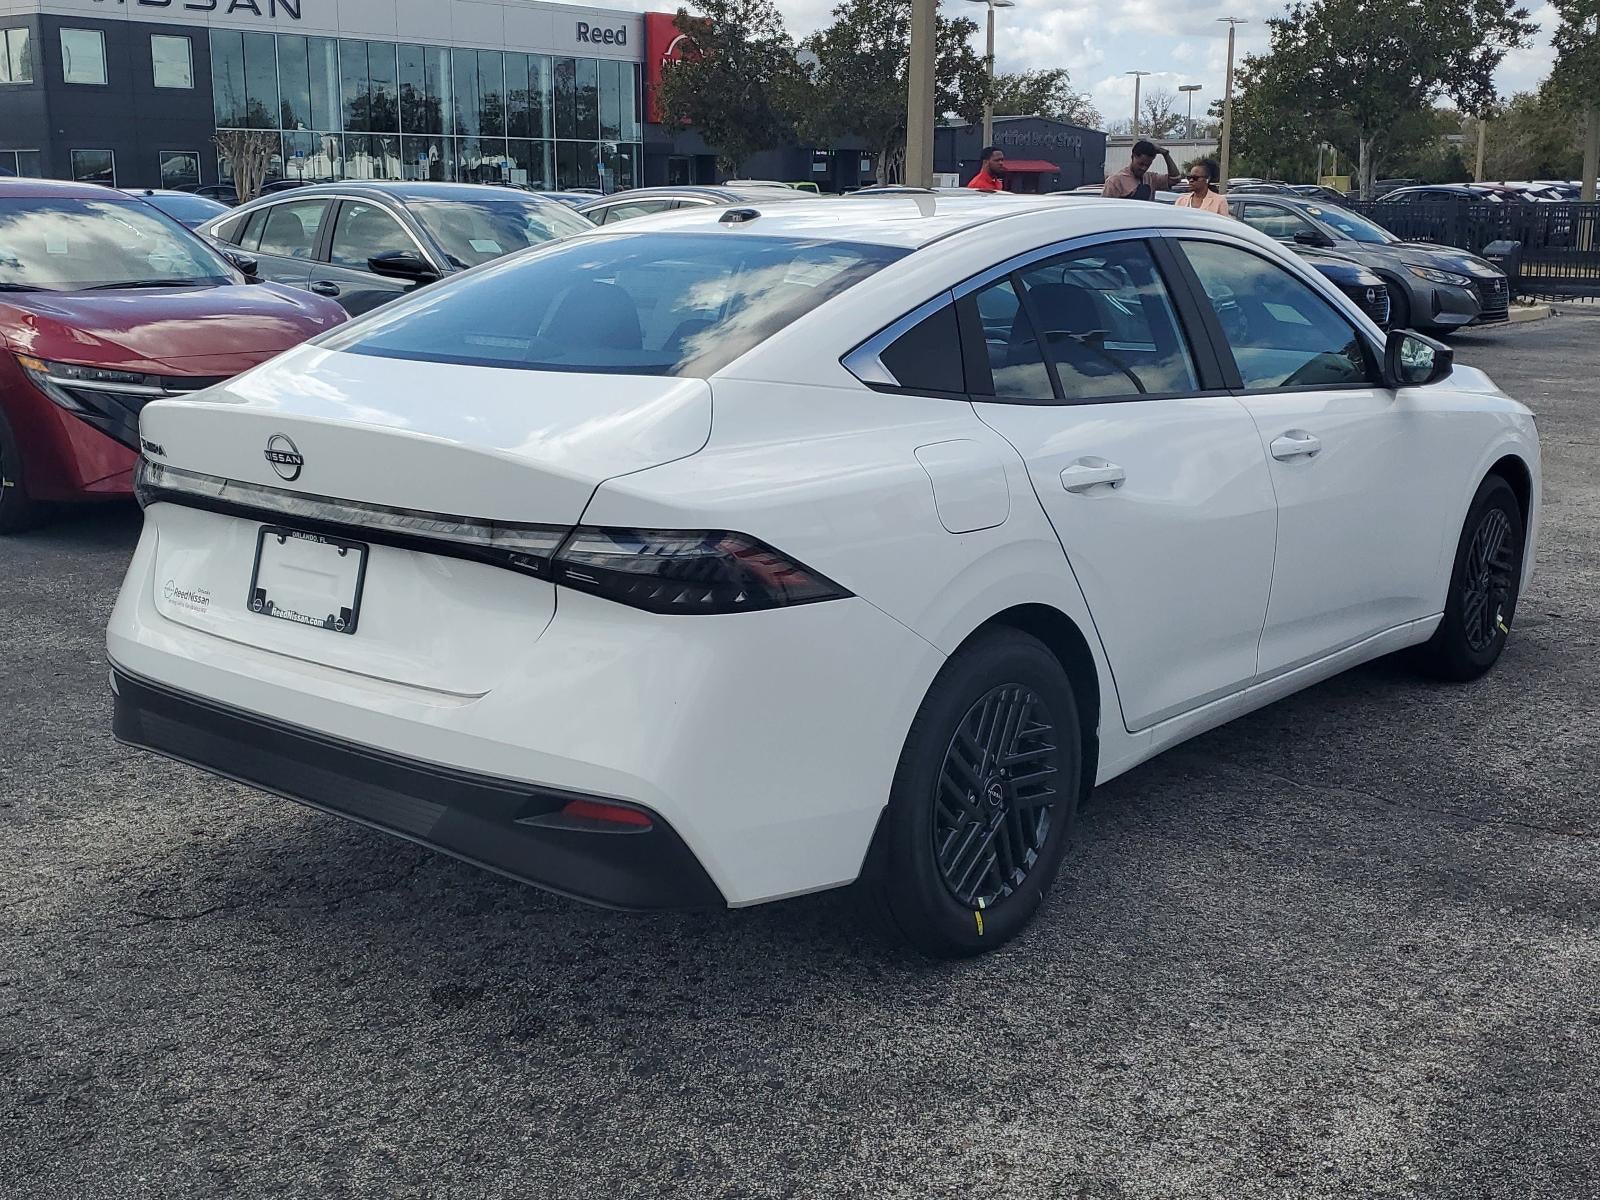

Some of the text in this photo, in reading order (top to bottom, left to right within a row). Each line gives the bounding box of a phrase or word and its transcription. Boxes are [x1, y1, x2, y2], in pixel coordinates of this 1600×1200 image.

[576, 21, 627, 46] Reed
[264, 450, 302, 465] NISSAN
[292, 531, 328, 544] ORLANDO, FL
[173, 587, 210, 606] ReedNissan
[271, 607, 324, 627] ReedNissan.com
